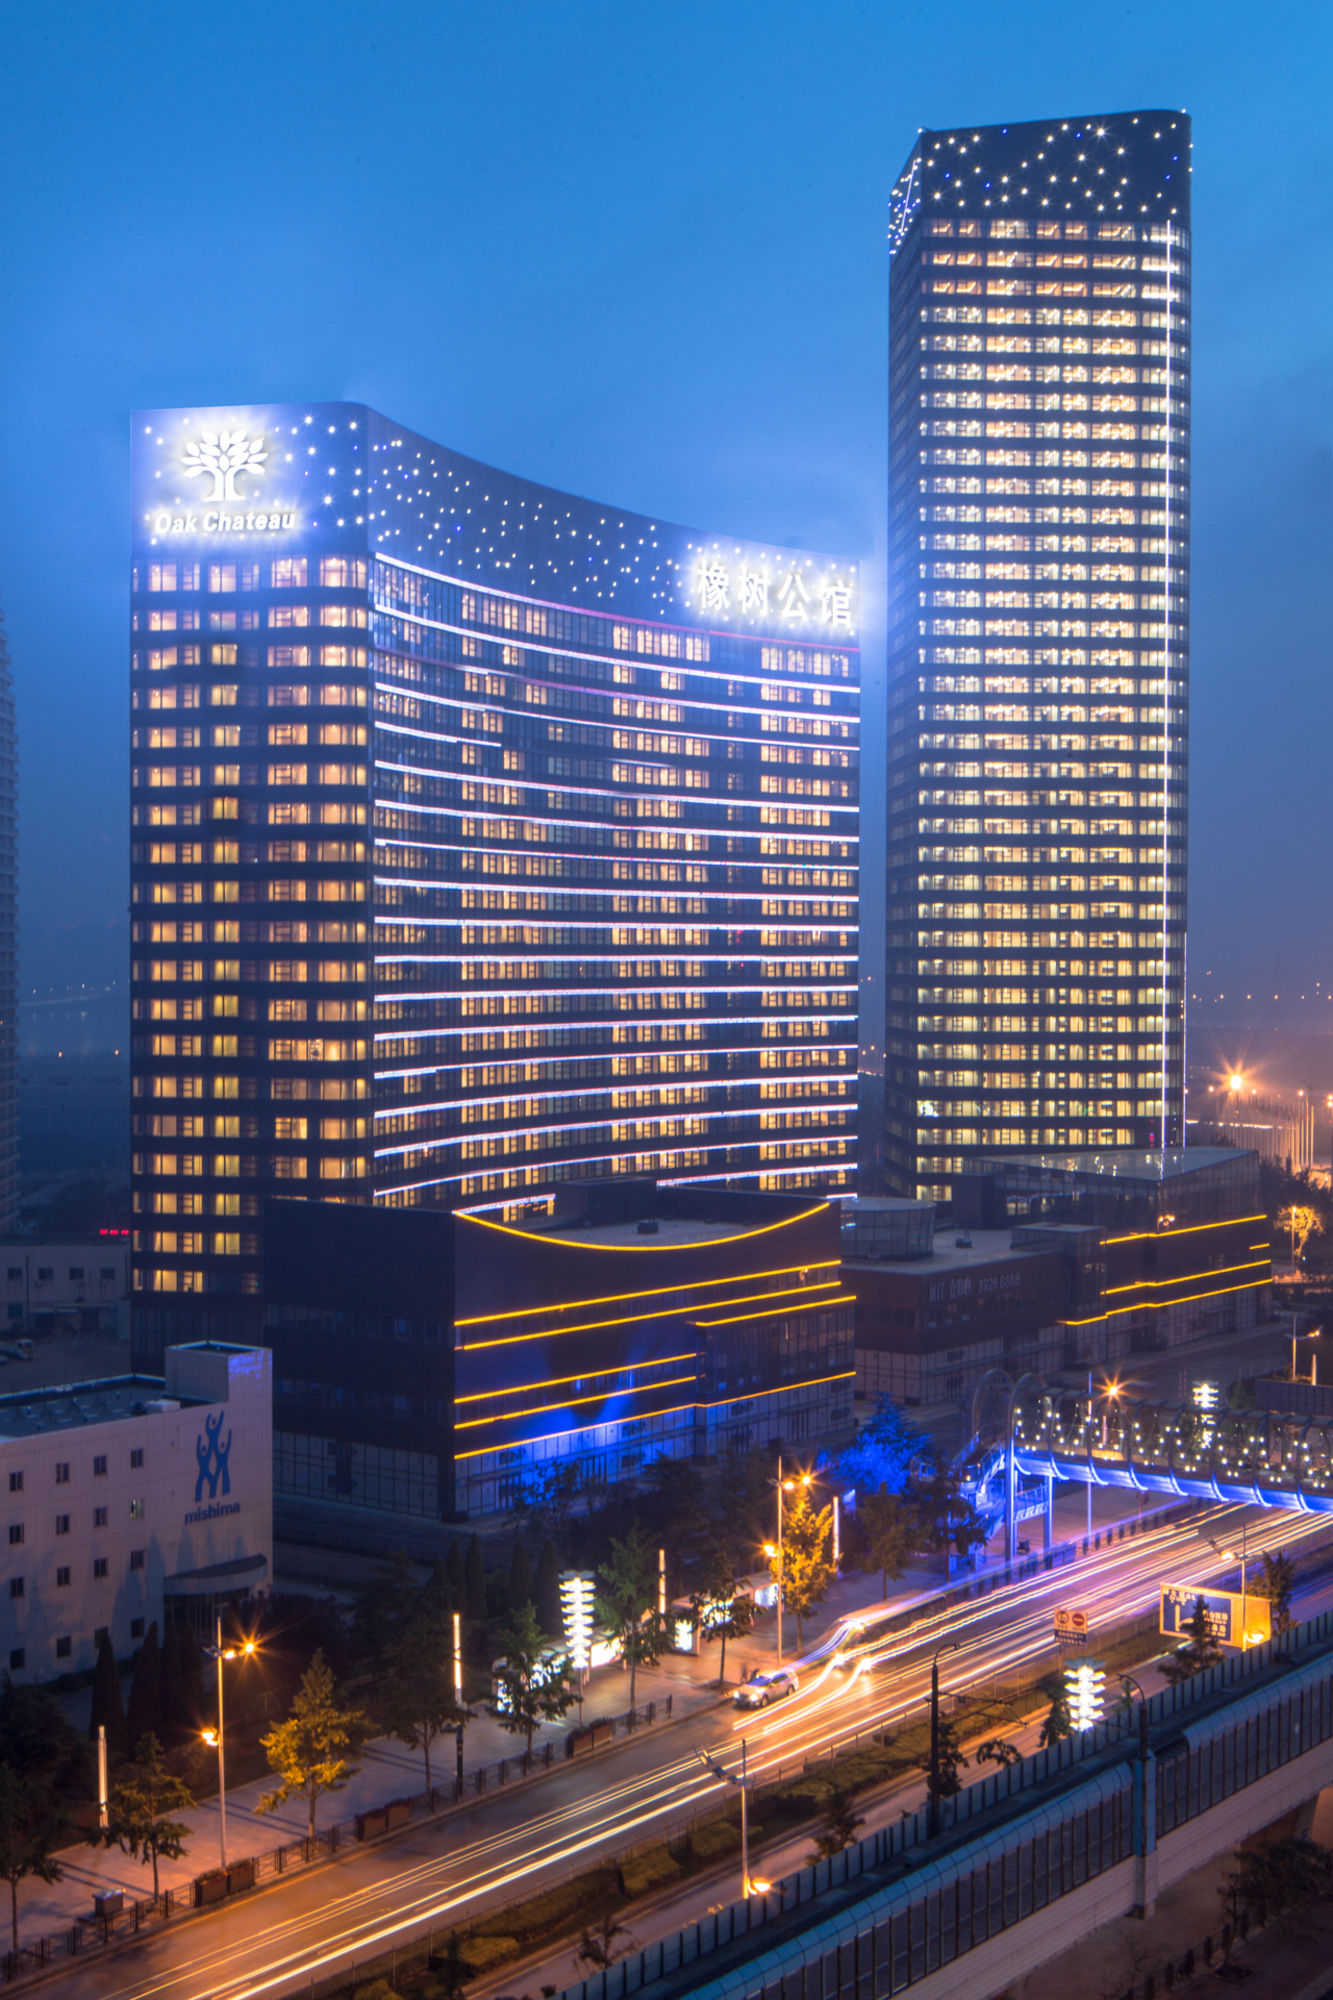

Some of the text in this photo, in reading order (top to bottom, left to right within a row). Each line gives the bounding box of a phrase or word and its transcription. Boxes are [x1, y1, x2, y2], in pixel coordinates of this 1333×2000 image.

[154, 510, 296, 534] Oak Chateau
[697, 559, 852, 628] 橡树公馆
[184, 1501, 240, 1525] mishima
